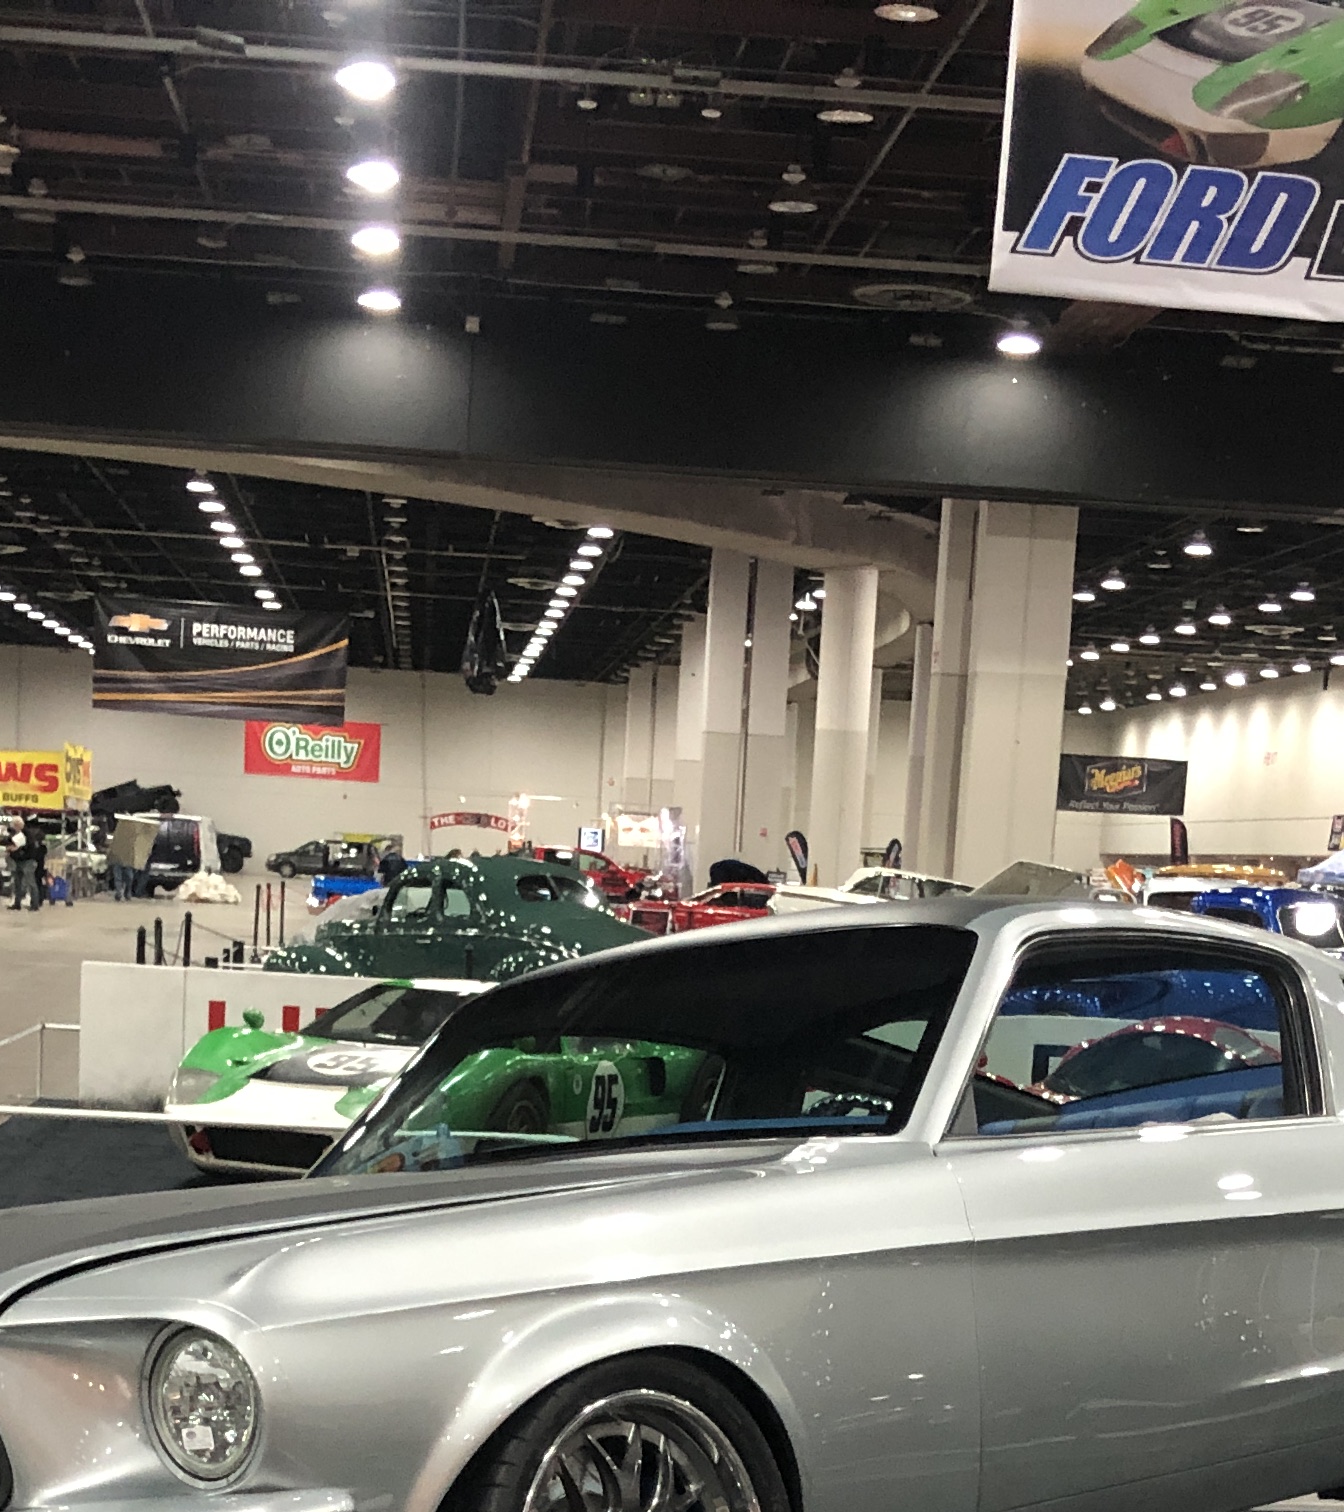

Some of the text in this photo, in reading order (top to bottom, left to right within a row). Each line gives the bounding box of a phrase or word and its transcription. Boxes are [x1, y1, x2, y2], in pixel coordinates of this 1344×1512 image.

[1013, 153, 1320, 276] FORD
[106, 634, 172, 648] CHEVROLET
[192, 622, 295, 644] PERFORMANCE
[264, 726, 360, 769] O'Reilly
[2, 791, 39, 804] BUFFS
[431, 814, 456, 828] THE
[320, 1053, 379, 1074] 95
[589, 1073, 620, 1134] 95
